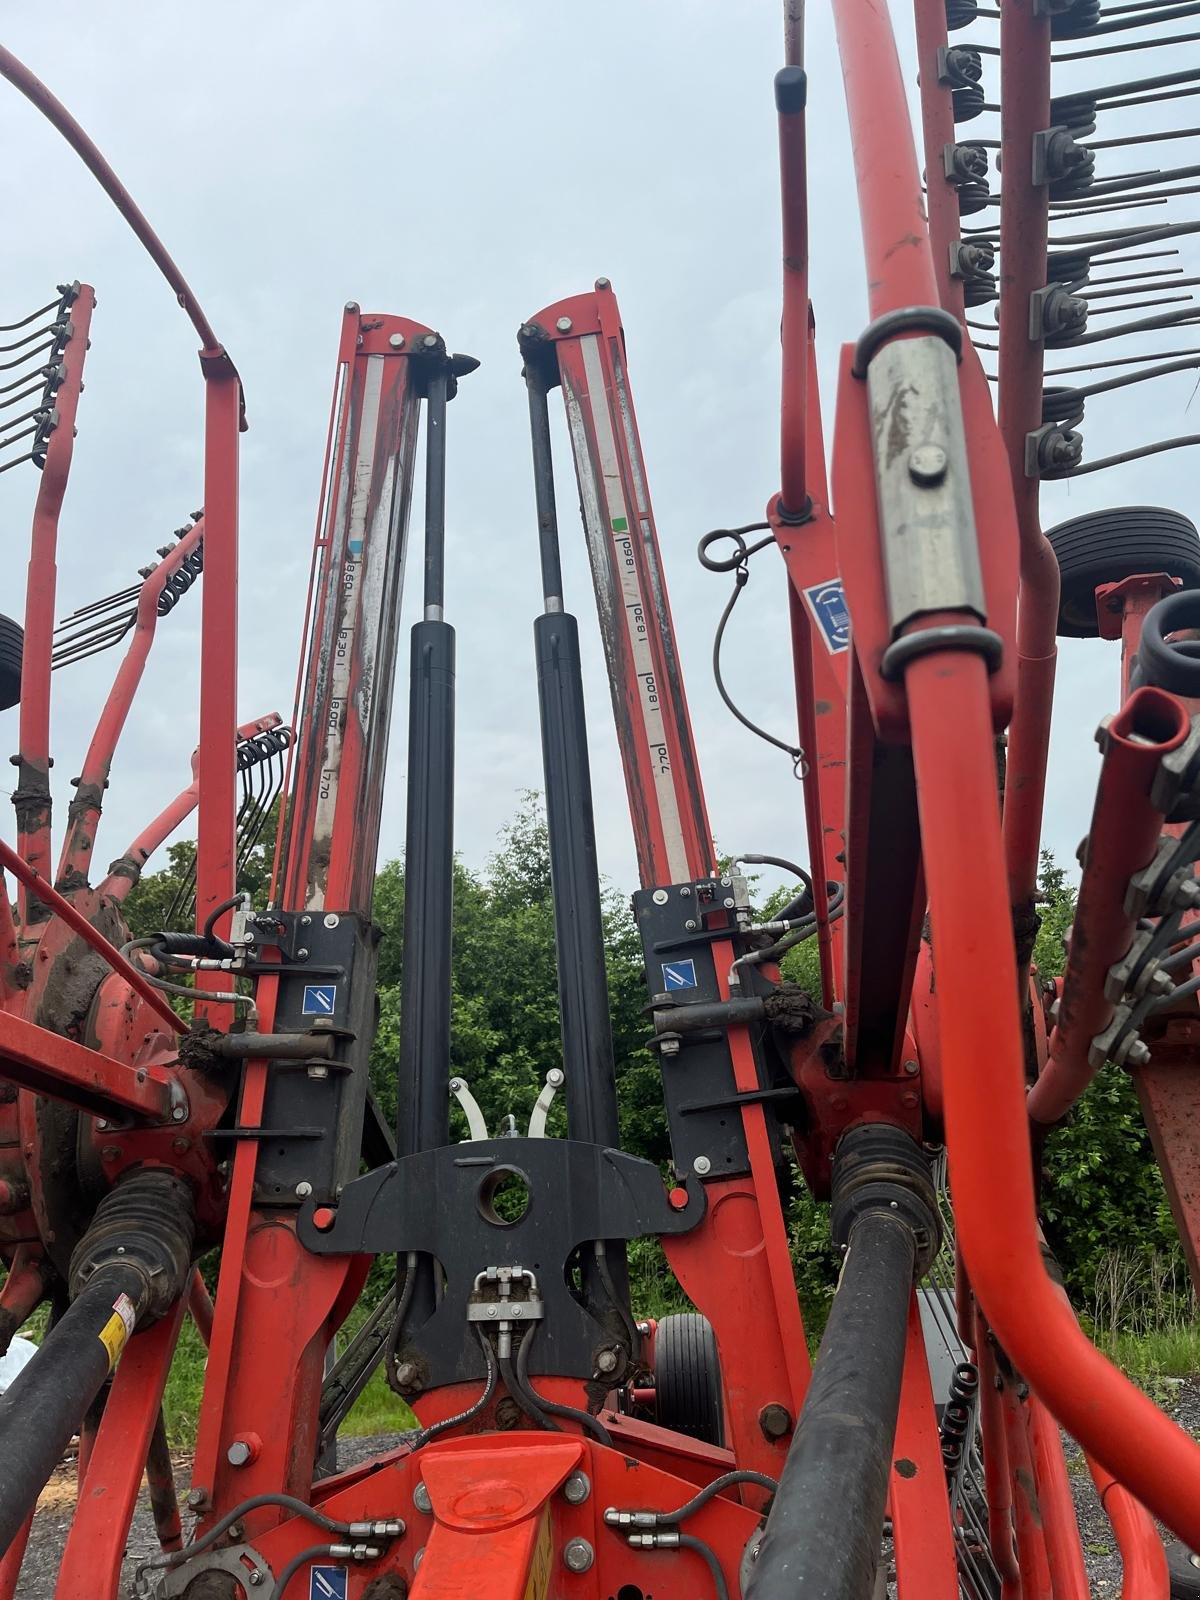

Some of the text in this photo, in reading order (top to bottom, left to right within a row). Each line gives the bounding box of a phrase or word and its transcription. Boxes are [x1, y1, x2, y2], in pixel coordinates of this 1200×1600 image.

[622, 541, 635, 566] 8.60
[344, 564, 355, 590] 8.60
[633, 607, 646, 633] 8.30
[337, 631, 348, 658] 8.30
[645, 676, 658, 703] 8.00
[328, 701, 340, 728] 8.00
[657, 747, 670, 774] 7.70
[320, 773, 331, 800] 7.70
